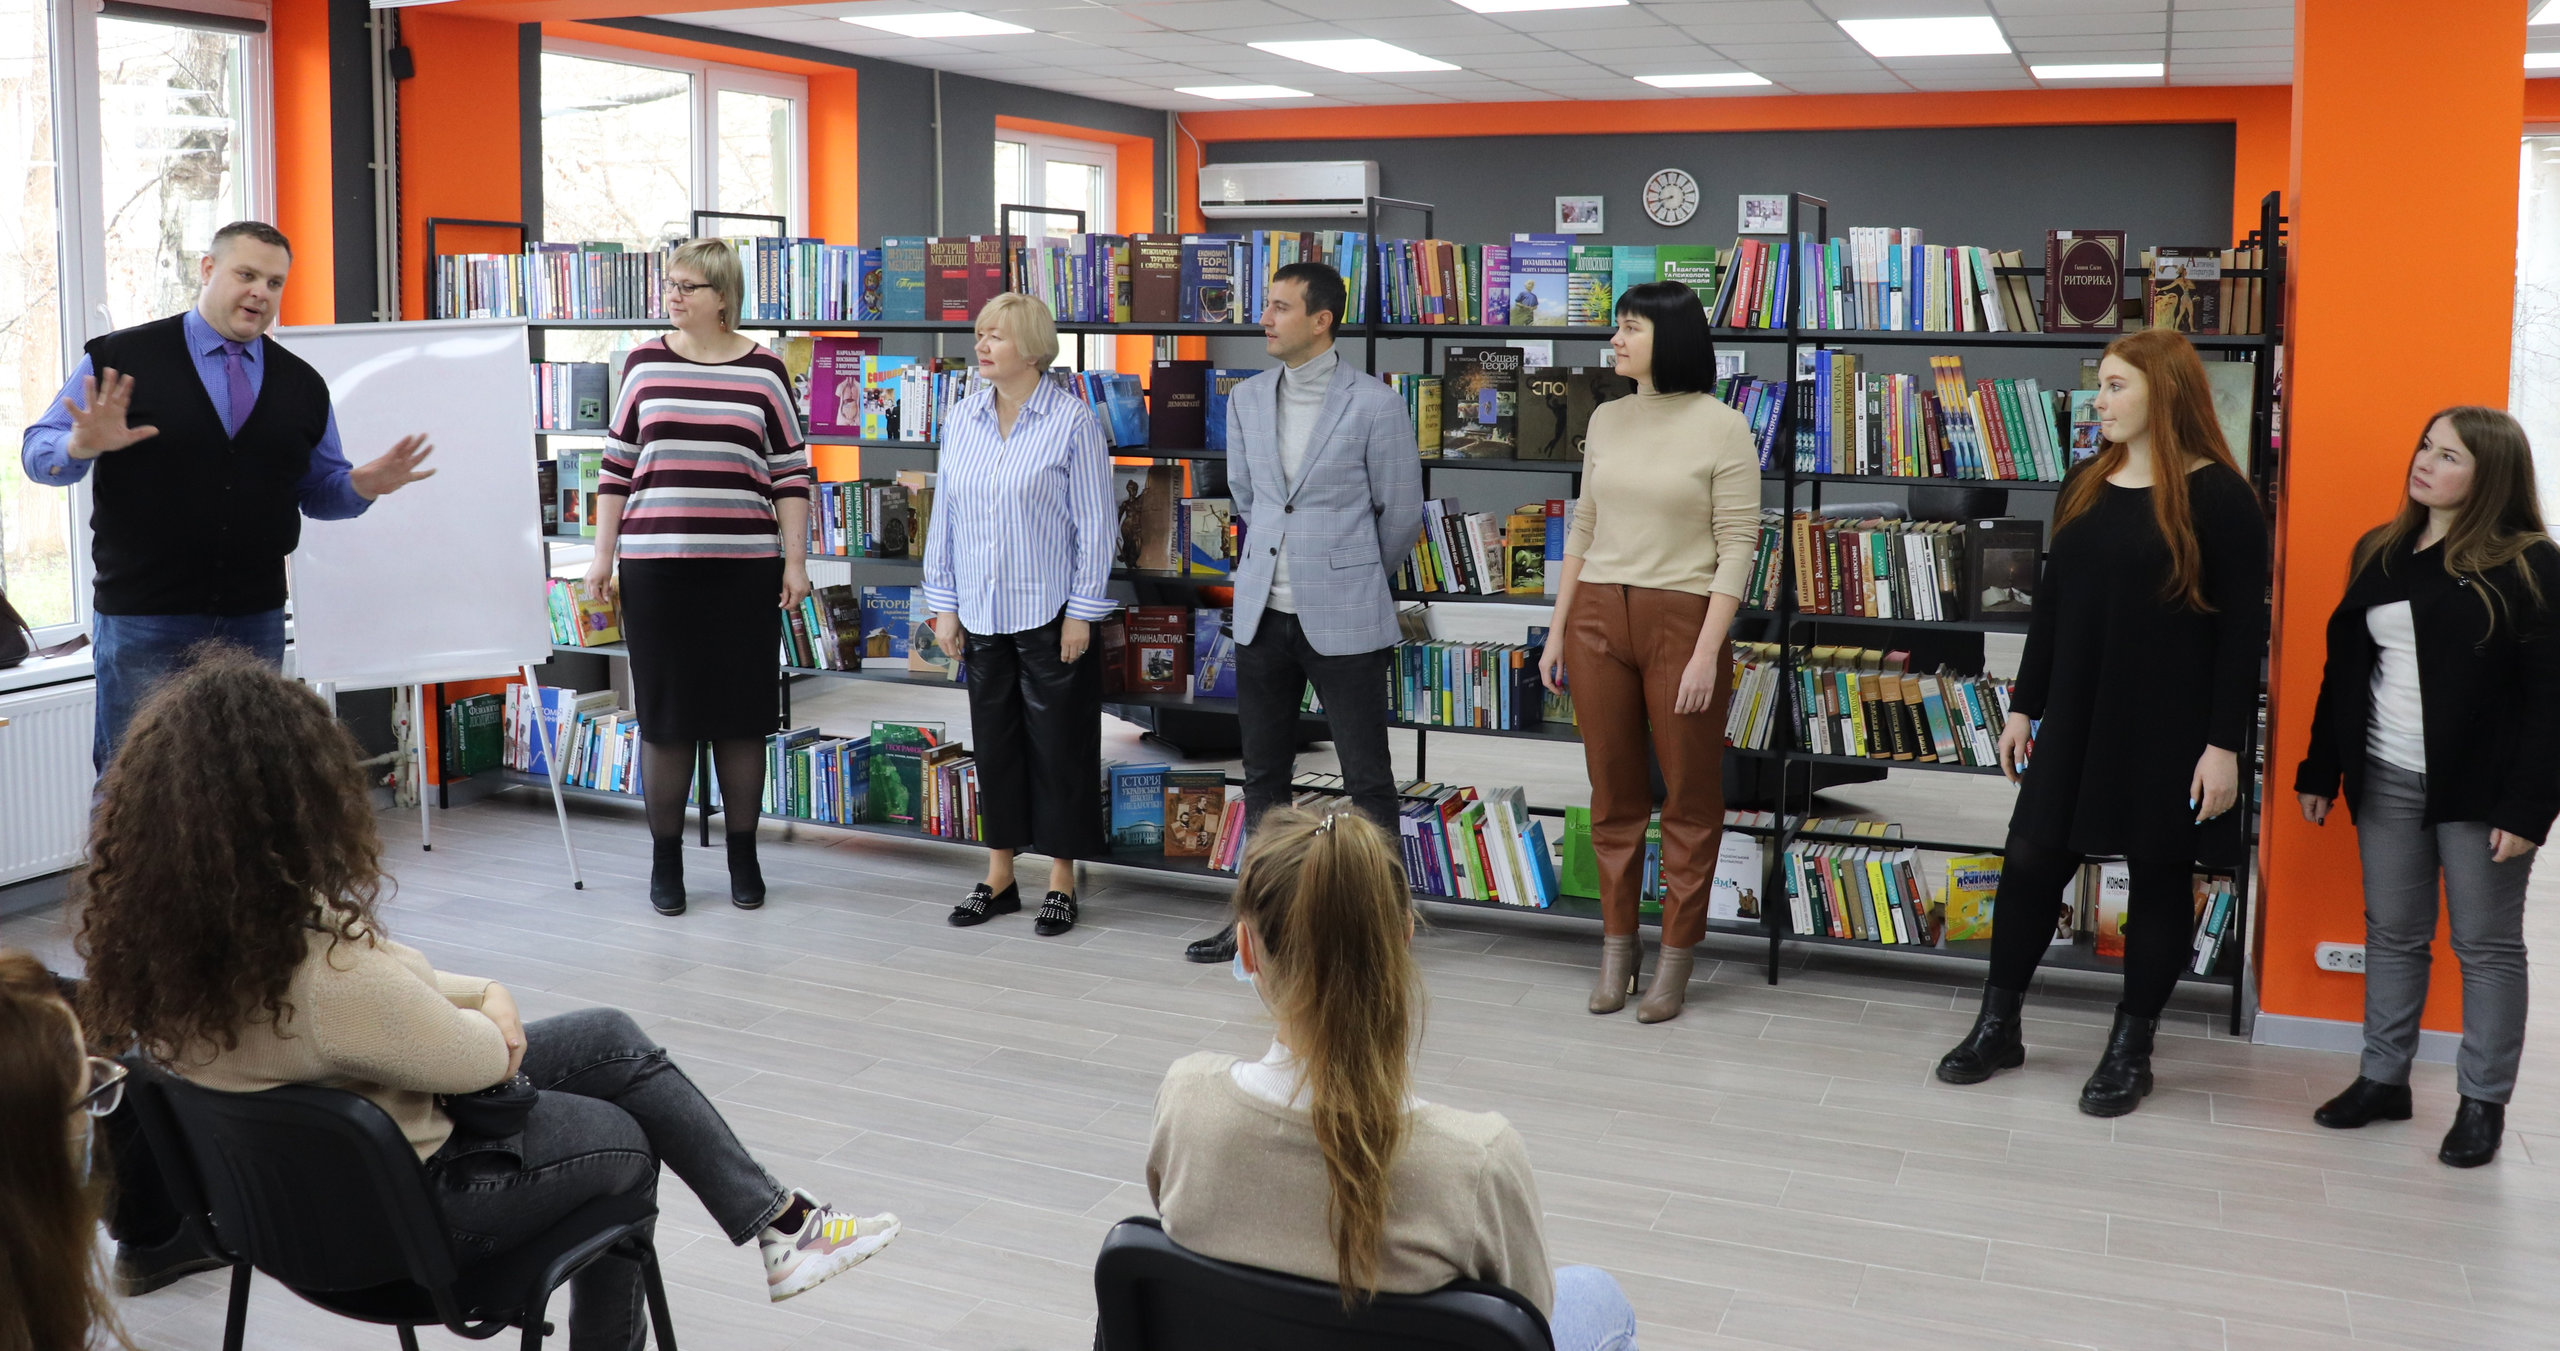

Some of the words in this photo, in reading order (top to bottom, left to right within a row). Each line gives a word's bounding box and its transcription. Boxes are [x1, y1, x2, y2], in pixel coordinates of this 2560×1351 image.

[1664, 261, 1710, 273] ПЕДАГОГІКА
[2064, 276, 2112, 286] РИТОРИКА
[1479, 351, 1518, 363] Общая
[1833, 365, 1842, 414] РИСУНКА
[867, 599, 911, 609] ІСТОРІЯ
[1129, 633, 1184, 644] КРИМІНАЛІСТИКА
[1121, 774, 1162, 787] ІСТОРІЯ
